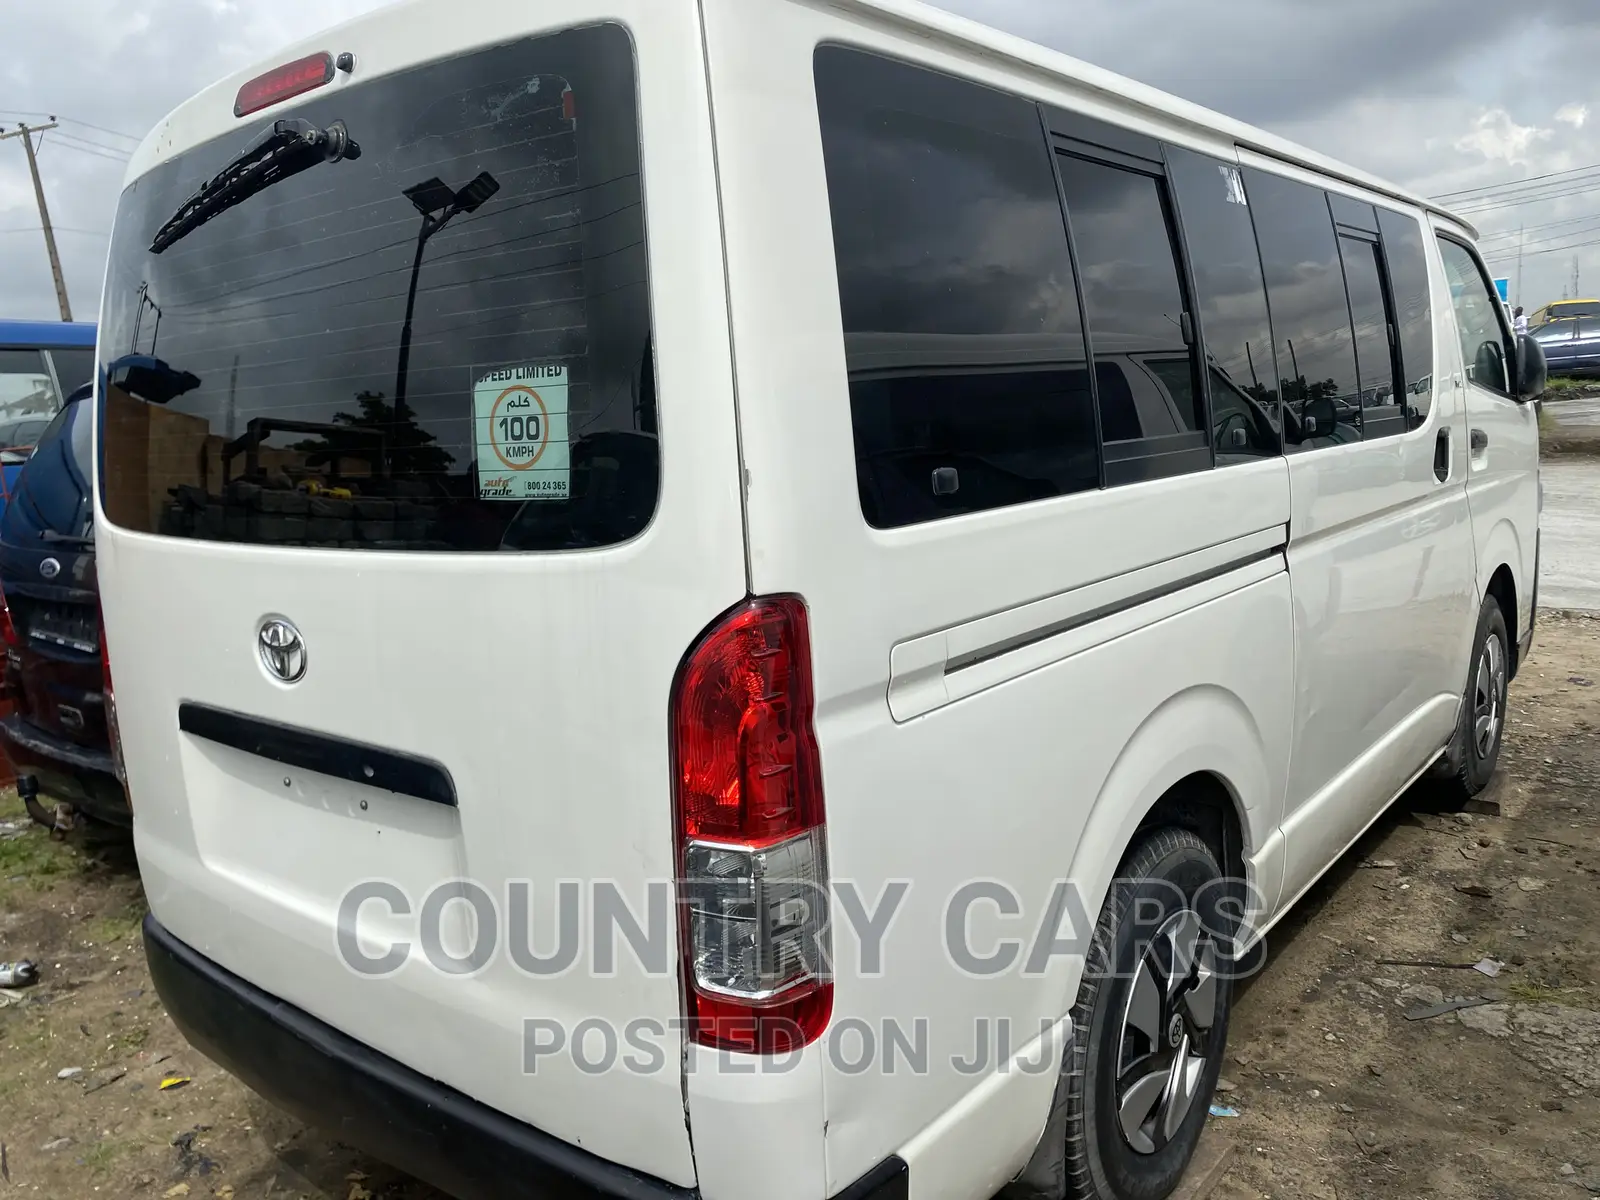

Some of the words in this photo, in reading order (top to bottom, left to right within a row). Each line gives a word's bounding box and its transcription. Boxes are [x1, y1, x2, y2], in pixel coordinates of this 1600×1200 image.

[515, 365, 563, 380] LIMITED
[506, 394, 531, 413] كلم
[499, 415, 541, 442] 100
[505, 445, 535, 458] KMPH
[479, 486, 513, 498] grade
[527, 481, 541, 491] 800
[542, 481, 552, 491] 24
[552, 481, 567, 491] 365
